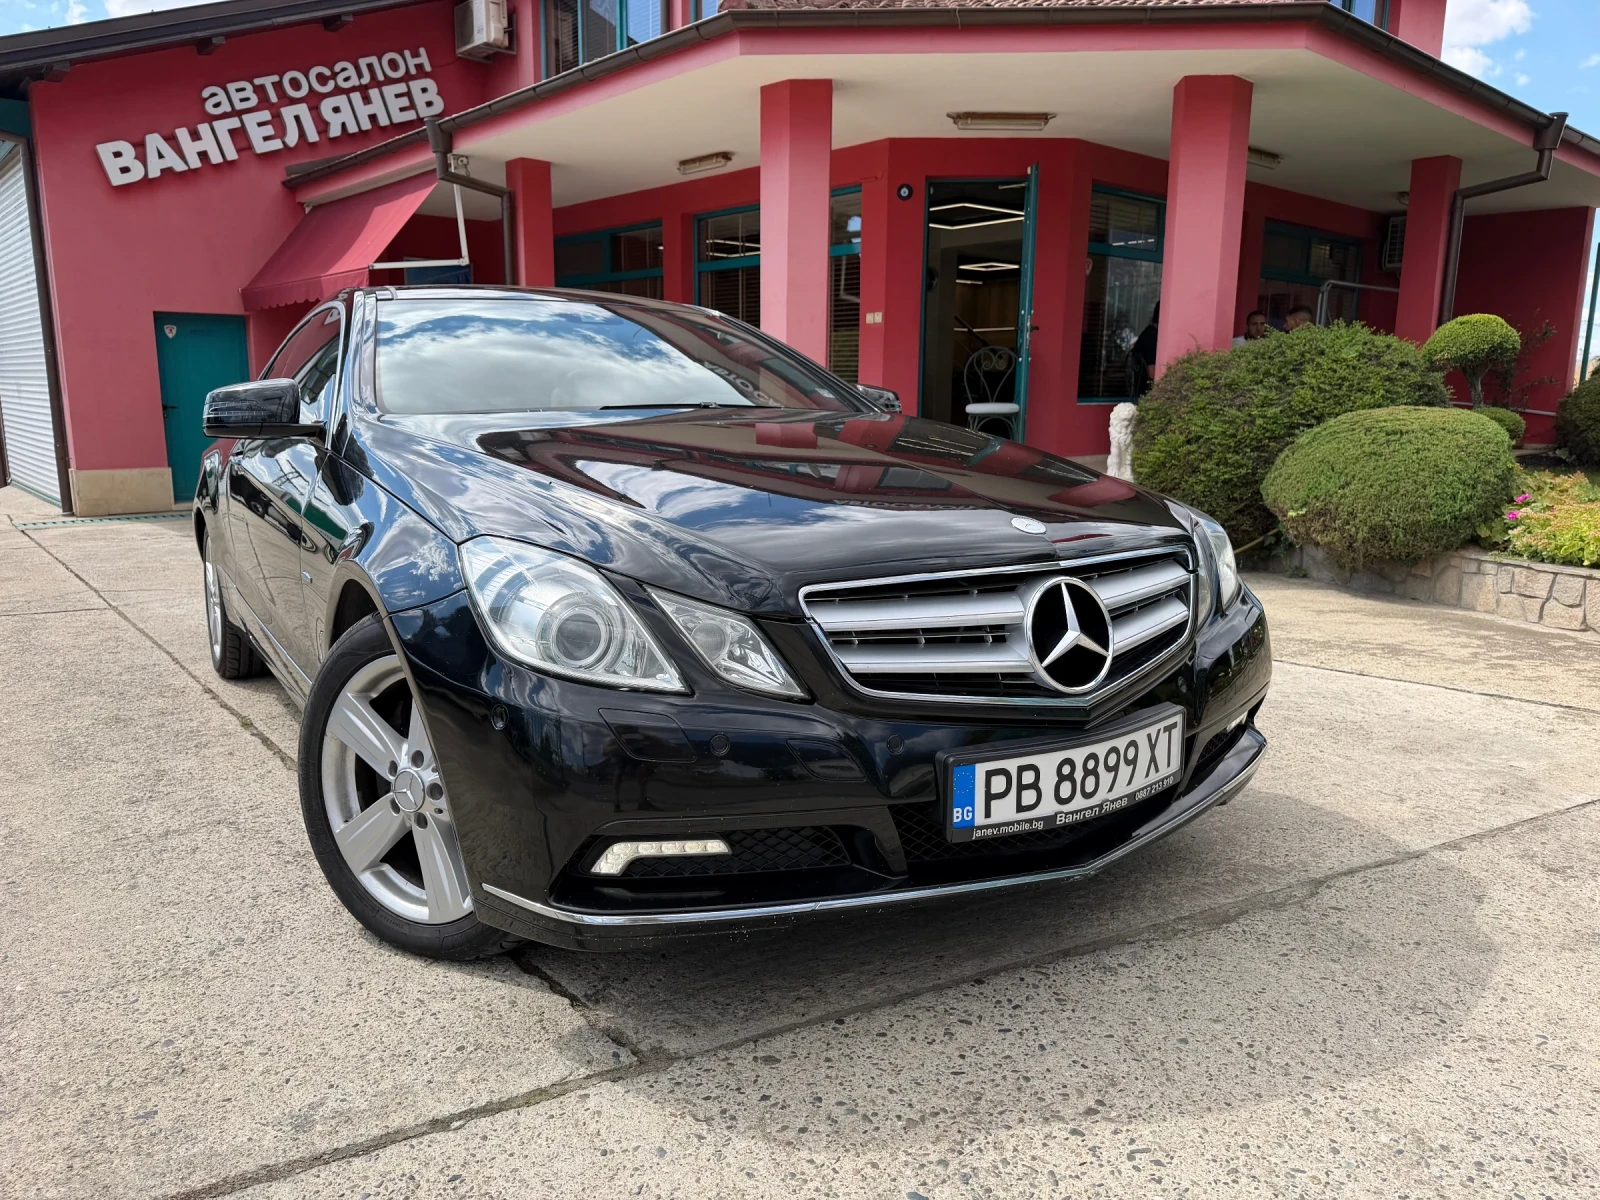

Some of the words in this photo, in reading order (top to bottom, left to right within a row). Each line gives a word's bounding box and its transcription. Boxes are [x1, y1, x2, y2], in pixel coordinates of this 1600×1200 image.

[202, 47, 432, 115] автосалон
[95, 103, 320, 187] ВАНГЕЛ
[319, 78, 445, 138] ЯНЕВ
[984, 763, 1042, 819] PB
[1054, 739, 1139, 805] 8899
[1145, 721, 1178, 779] XT
[953, 805, 973, 823] BG
[972, 819, 1044, 839] janev.mobile.bg
[1056, 806, 1099, 825] Вангел
[1101, 797, 1128, 813] Янев
